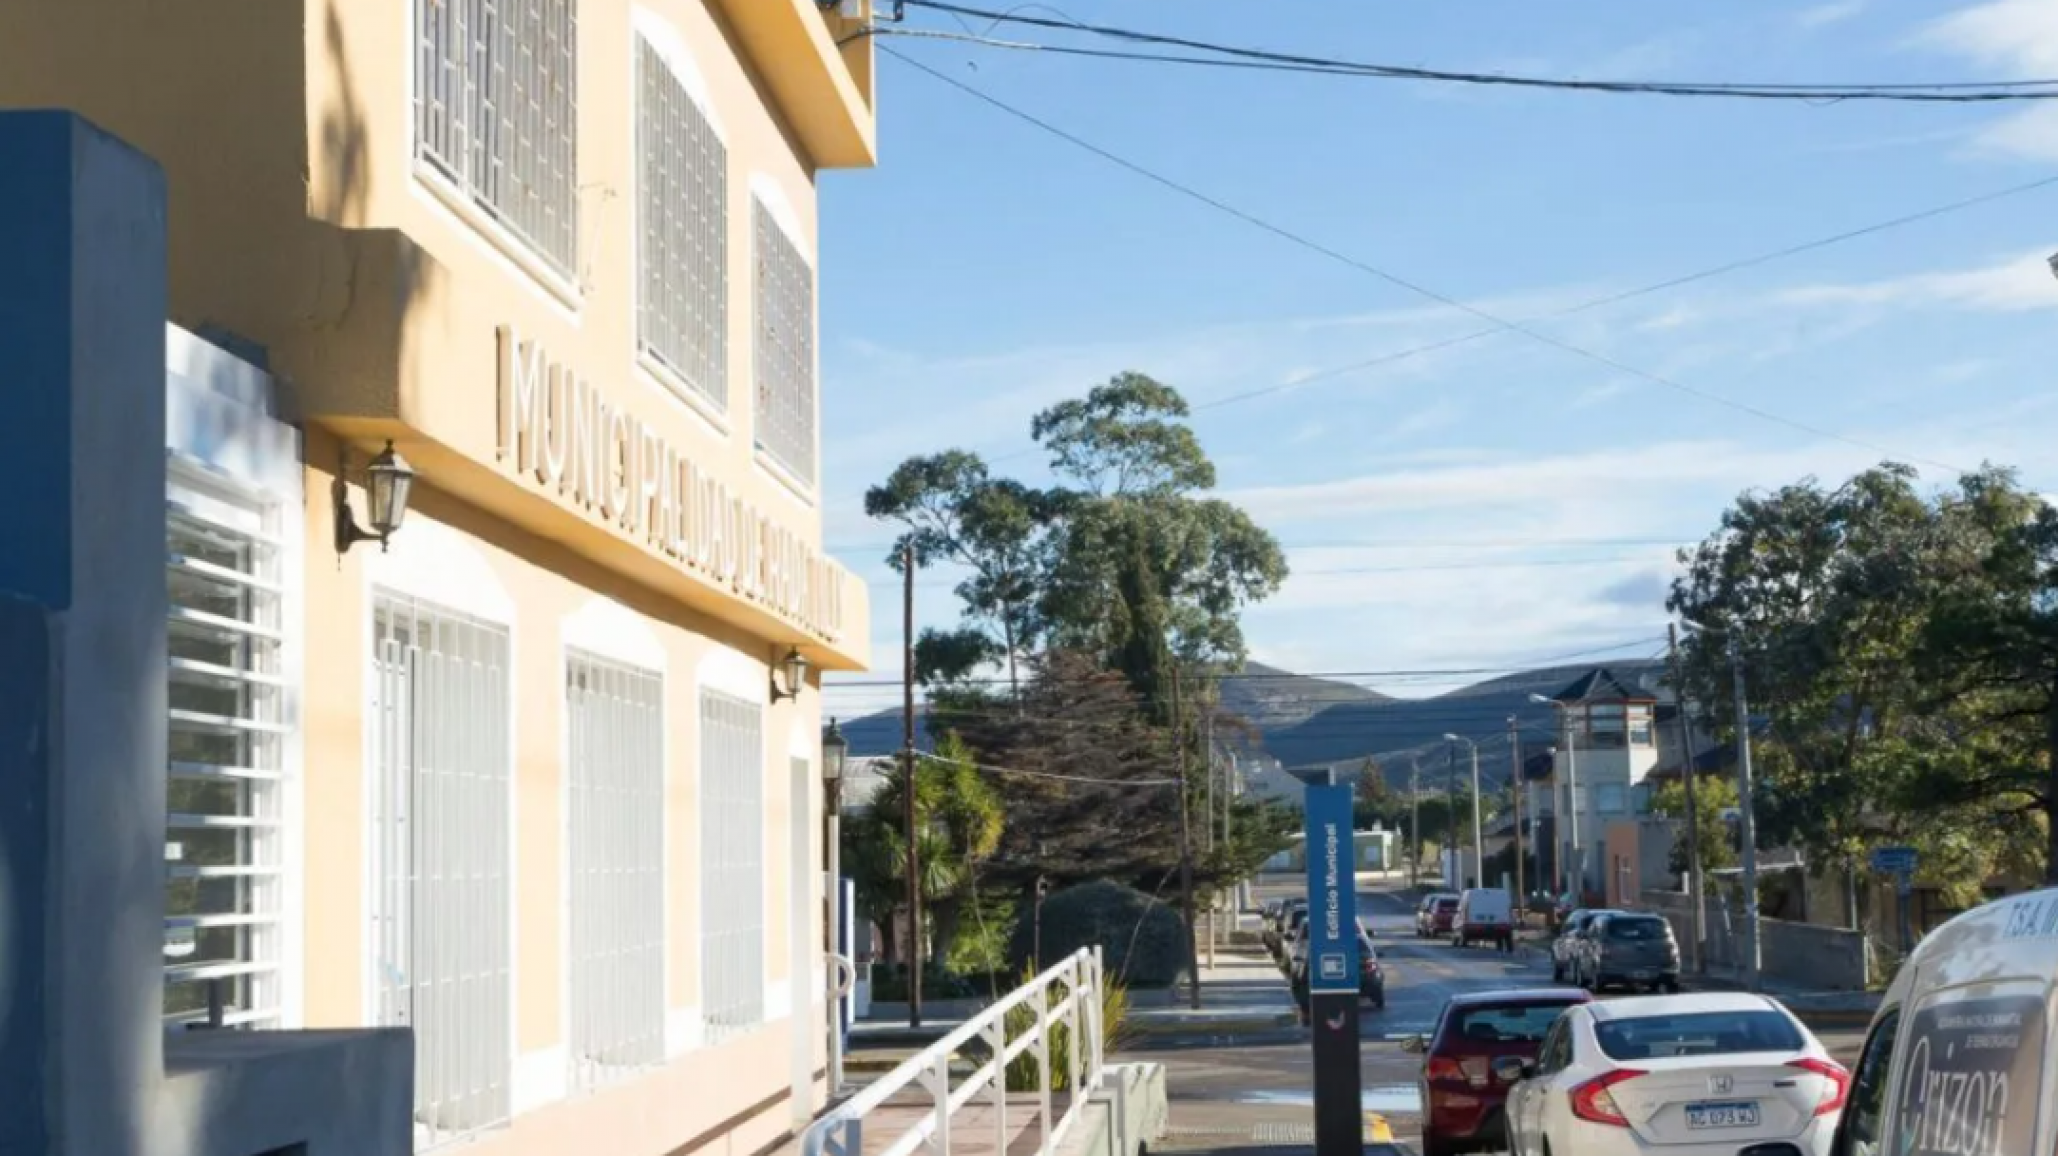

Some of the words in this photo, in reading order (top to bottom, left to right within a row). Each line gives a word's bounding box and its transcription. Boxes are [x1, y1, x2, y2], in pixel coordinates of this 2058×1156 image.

[498, 325, 738, 580] MUNICIPALIDAD
[1324, 823, 1339, 887] Municipal
[1326, 889, 1339, 940] Edificio
